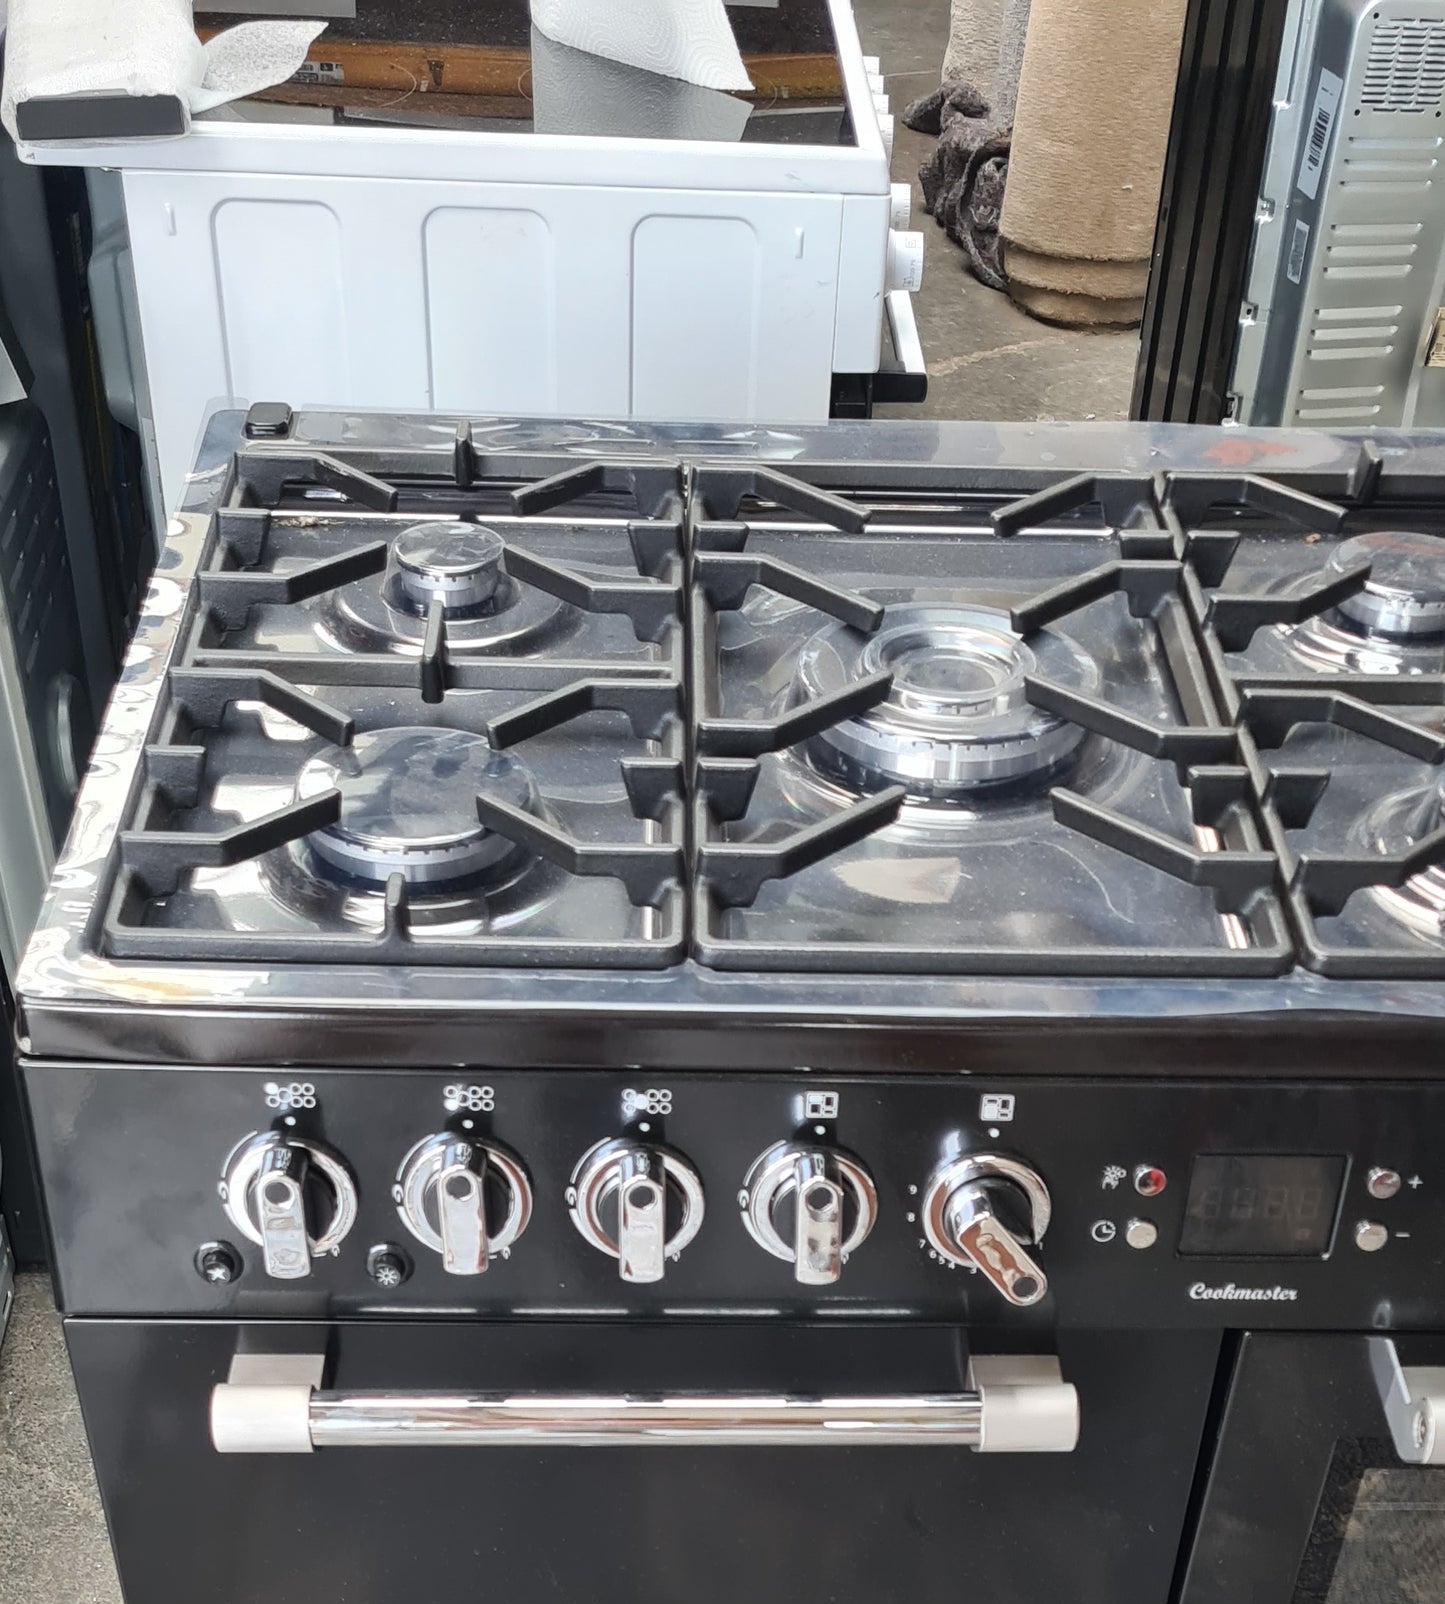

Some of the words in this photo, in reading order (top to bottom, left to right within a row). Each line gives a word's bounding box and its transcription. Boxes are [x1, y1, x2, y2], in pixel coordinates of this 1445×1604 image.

[909, 1184, 918, 1195] 9
[906, 1212, 916, 1223] 8
[919, 1238, 926, 1249] 7
[929, 1250, 937, 1259] 6
[1189, 1281, 1299, 1302] Cookmaster
